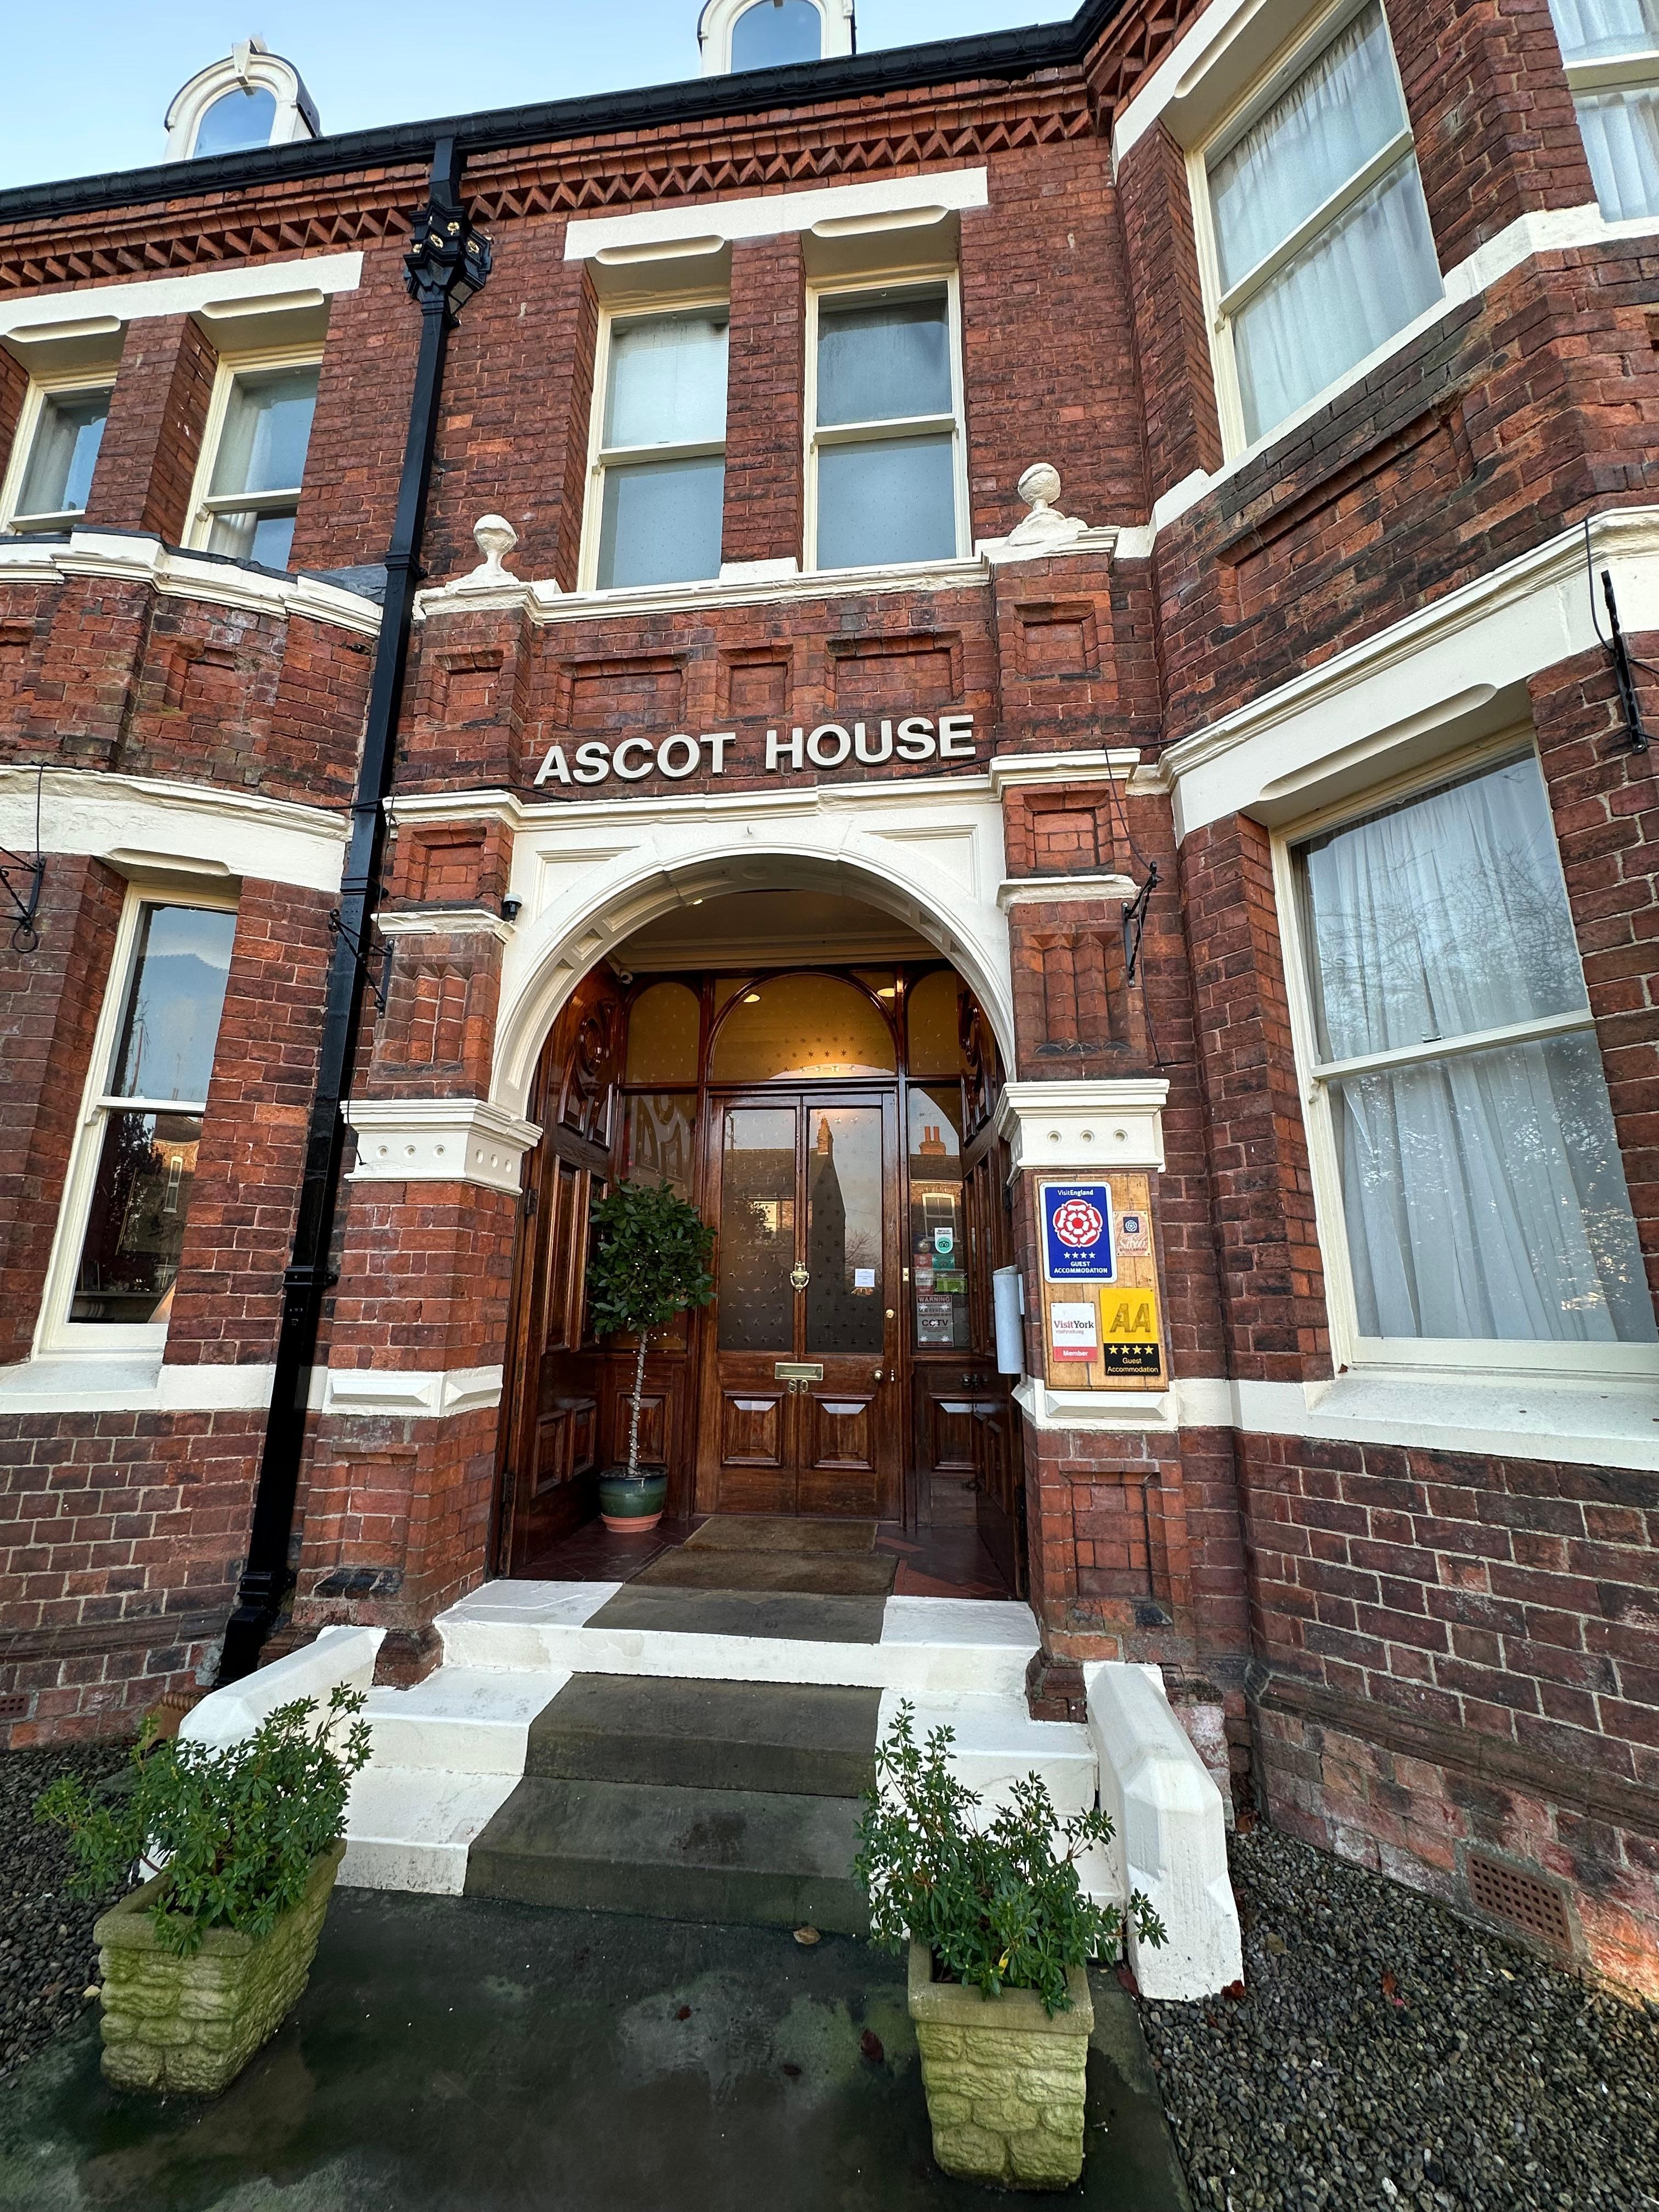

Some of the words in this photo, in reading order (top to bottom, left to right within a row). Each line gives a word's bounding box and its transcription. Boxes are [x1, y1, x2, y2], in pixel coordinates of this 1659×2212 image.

[533, 732, 736, 787] ASCOT
[765, 714, 976, 771] HOUSE
[1109, 1303, 1151, 1333] AA
